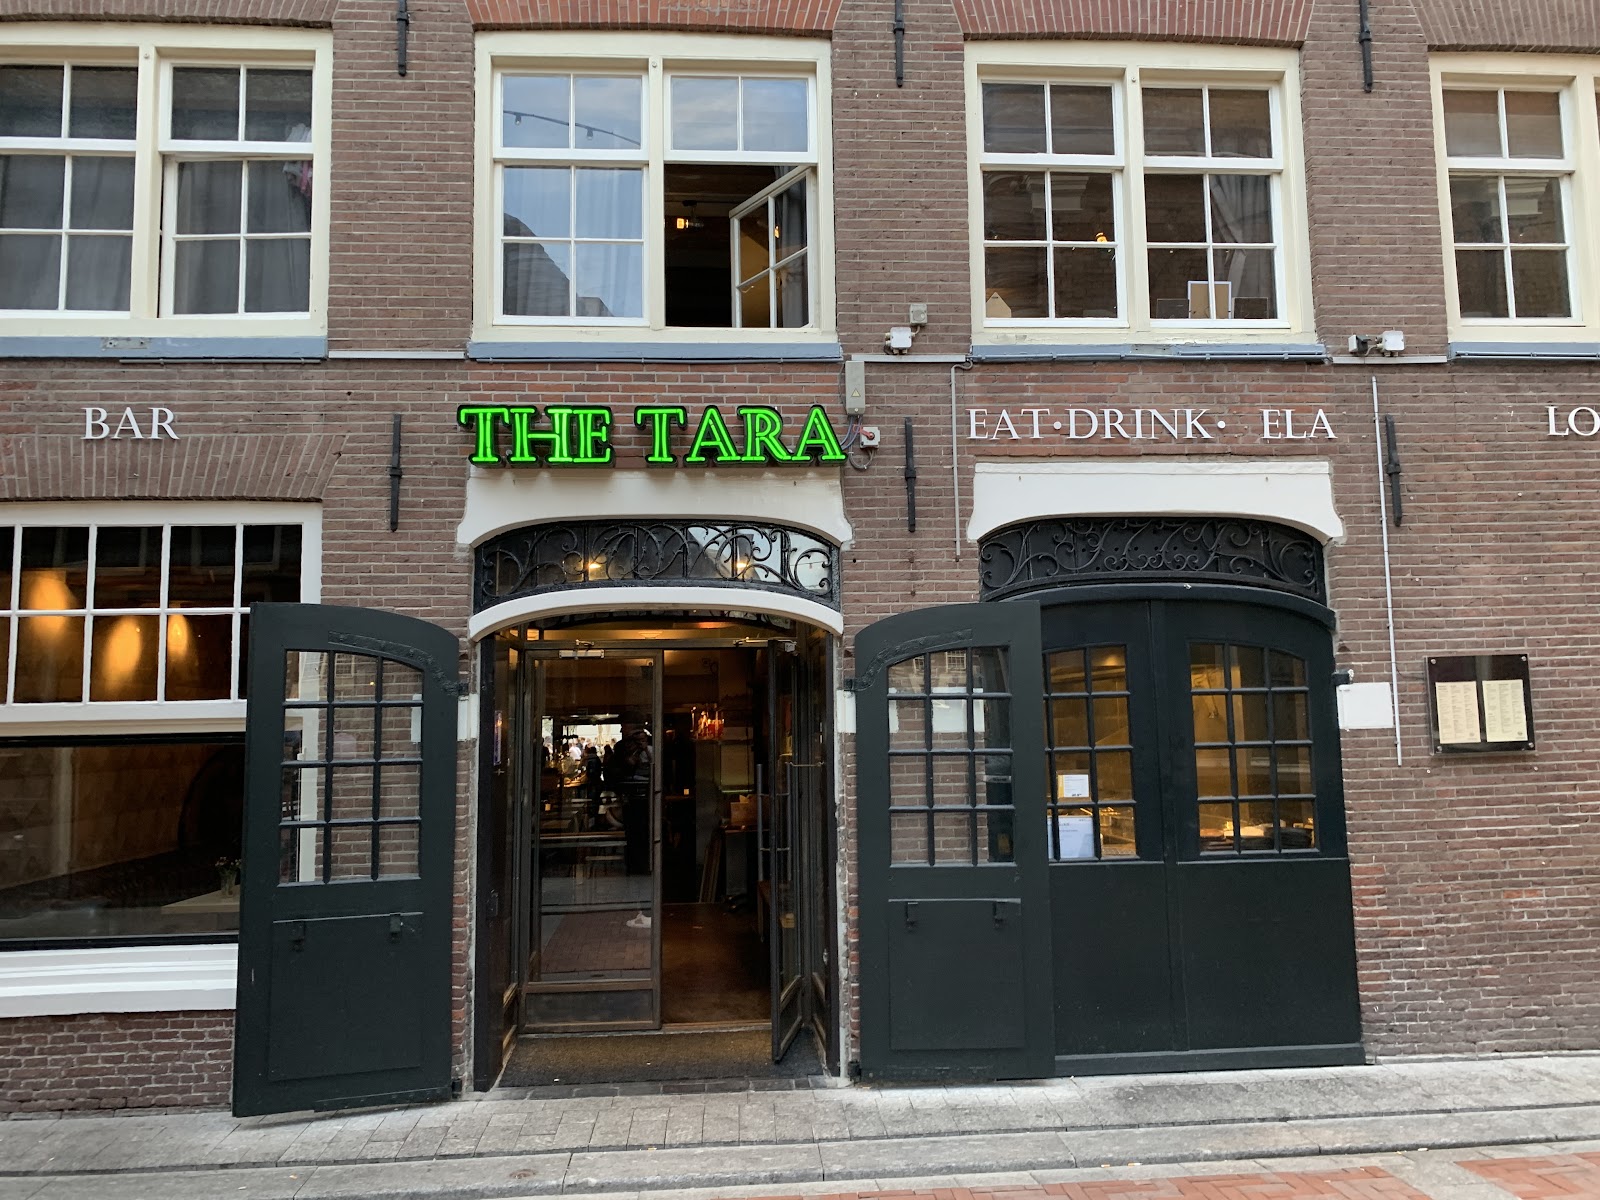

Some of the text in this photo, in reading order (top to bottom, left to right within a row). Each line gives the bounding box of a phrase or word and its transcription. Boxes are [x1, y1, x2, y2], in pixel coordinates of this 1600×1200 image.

[80, 406, 180, 440] BAR
[457, 405, 848, 467] THE TARA
[1260, 408, 1338, 440] ELA
[1544, 405, 1600, 437] LO
